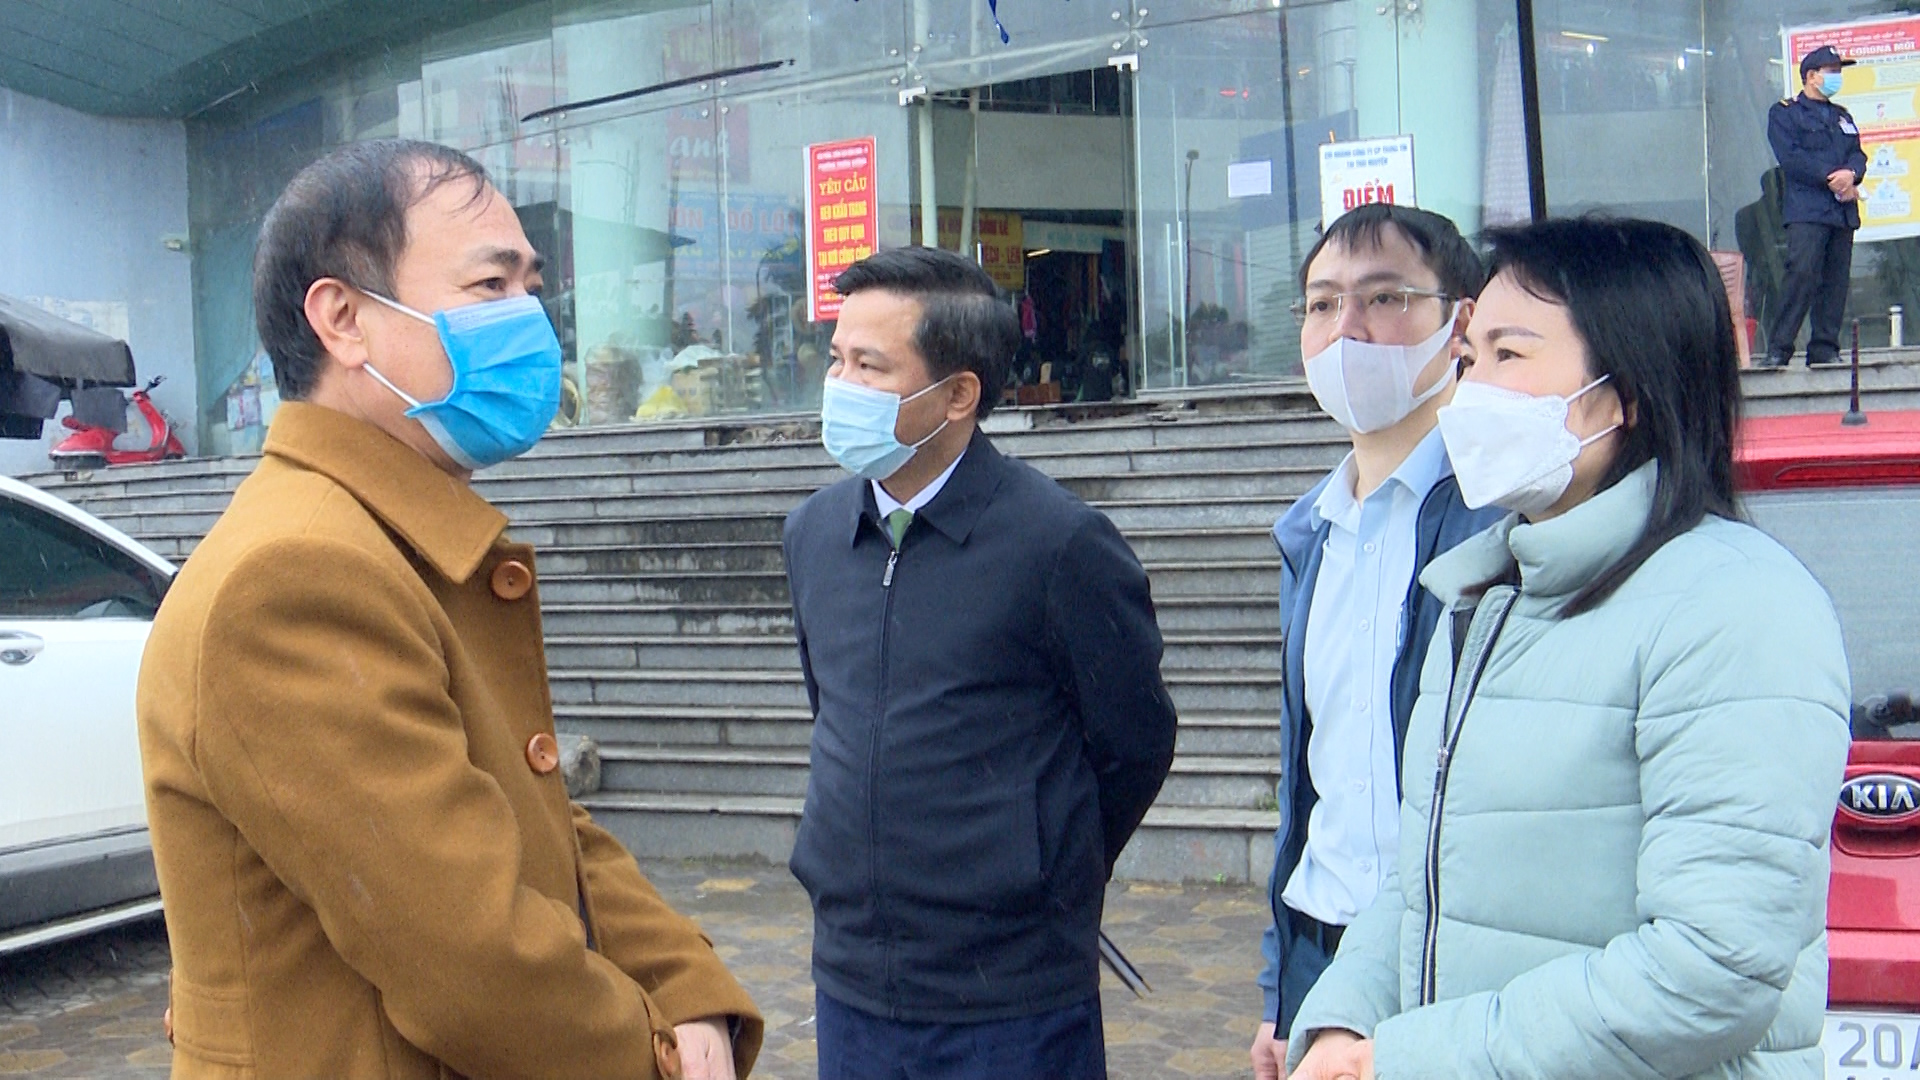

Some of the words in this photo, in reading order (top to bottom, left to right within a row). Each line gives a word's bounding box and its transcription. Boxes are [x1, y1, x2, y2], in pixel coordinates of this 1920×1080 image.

[1849, 45, 1892, 56] CORONA
[1894, 41, 1916, 52] MỚI
[819, 178, 841, 196] YÊU
[1343, 178, 1395, 212] ĐIỂM
[1851, 784, 1915, 809] KIA
